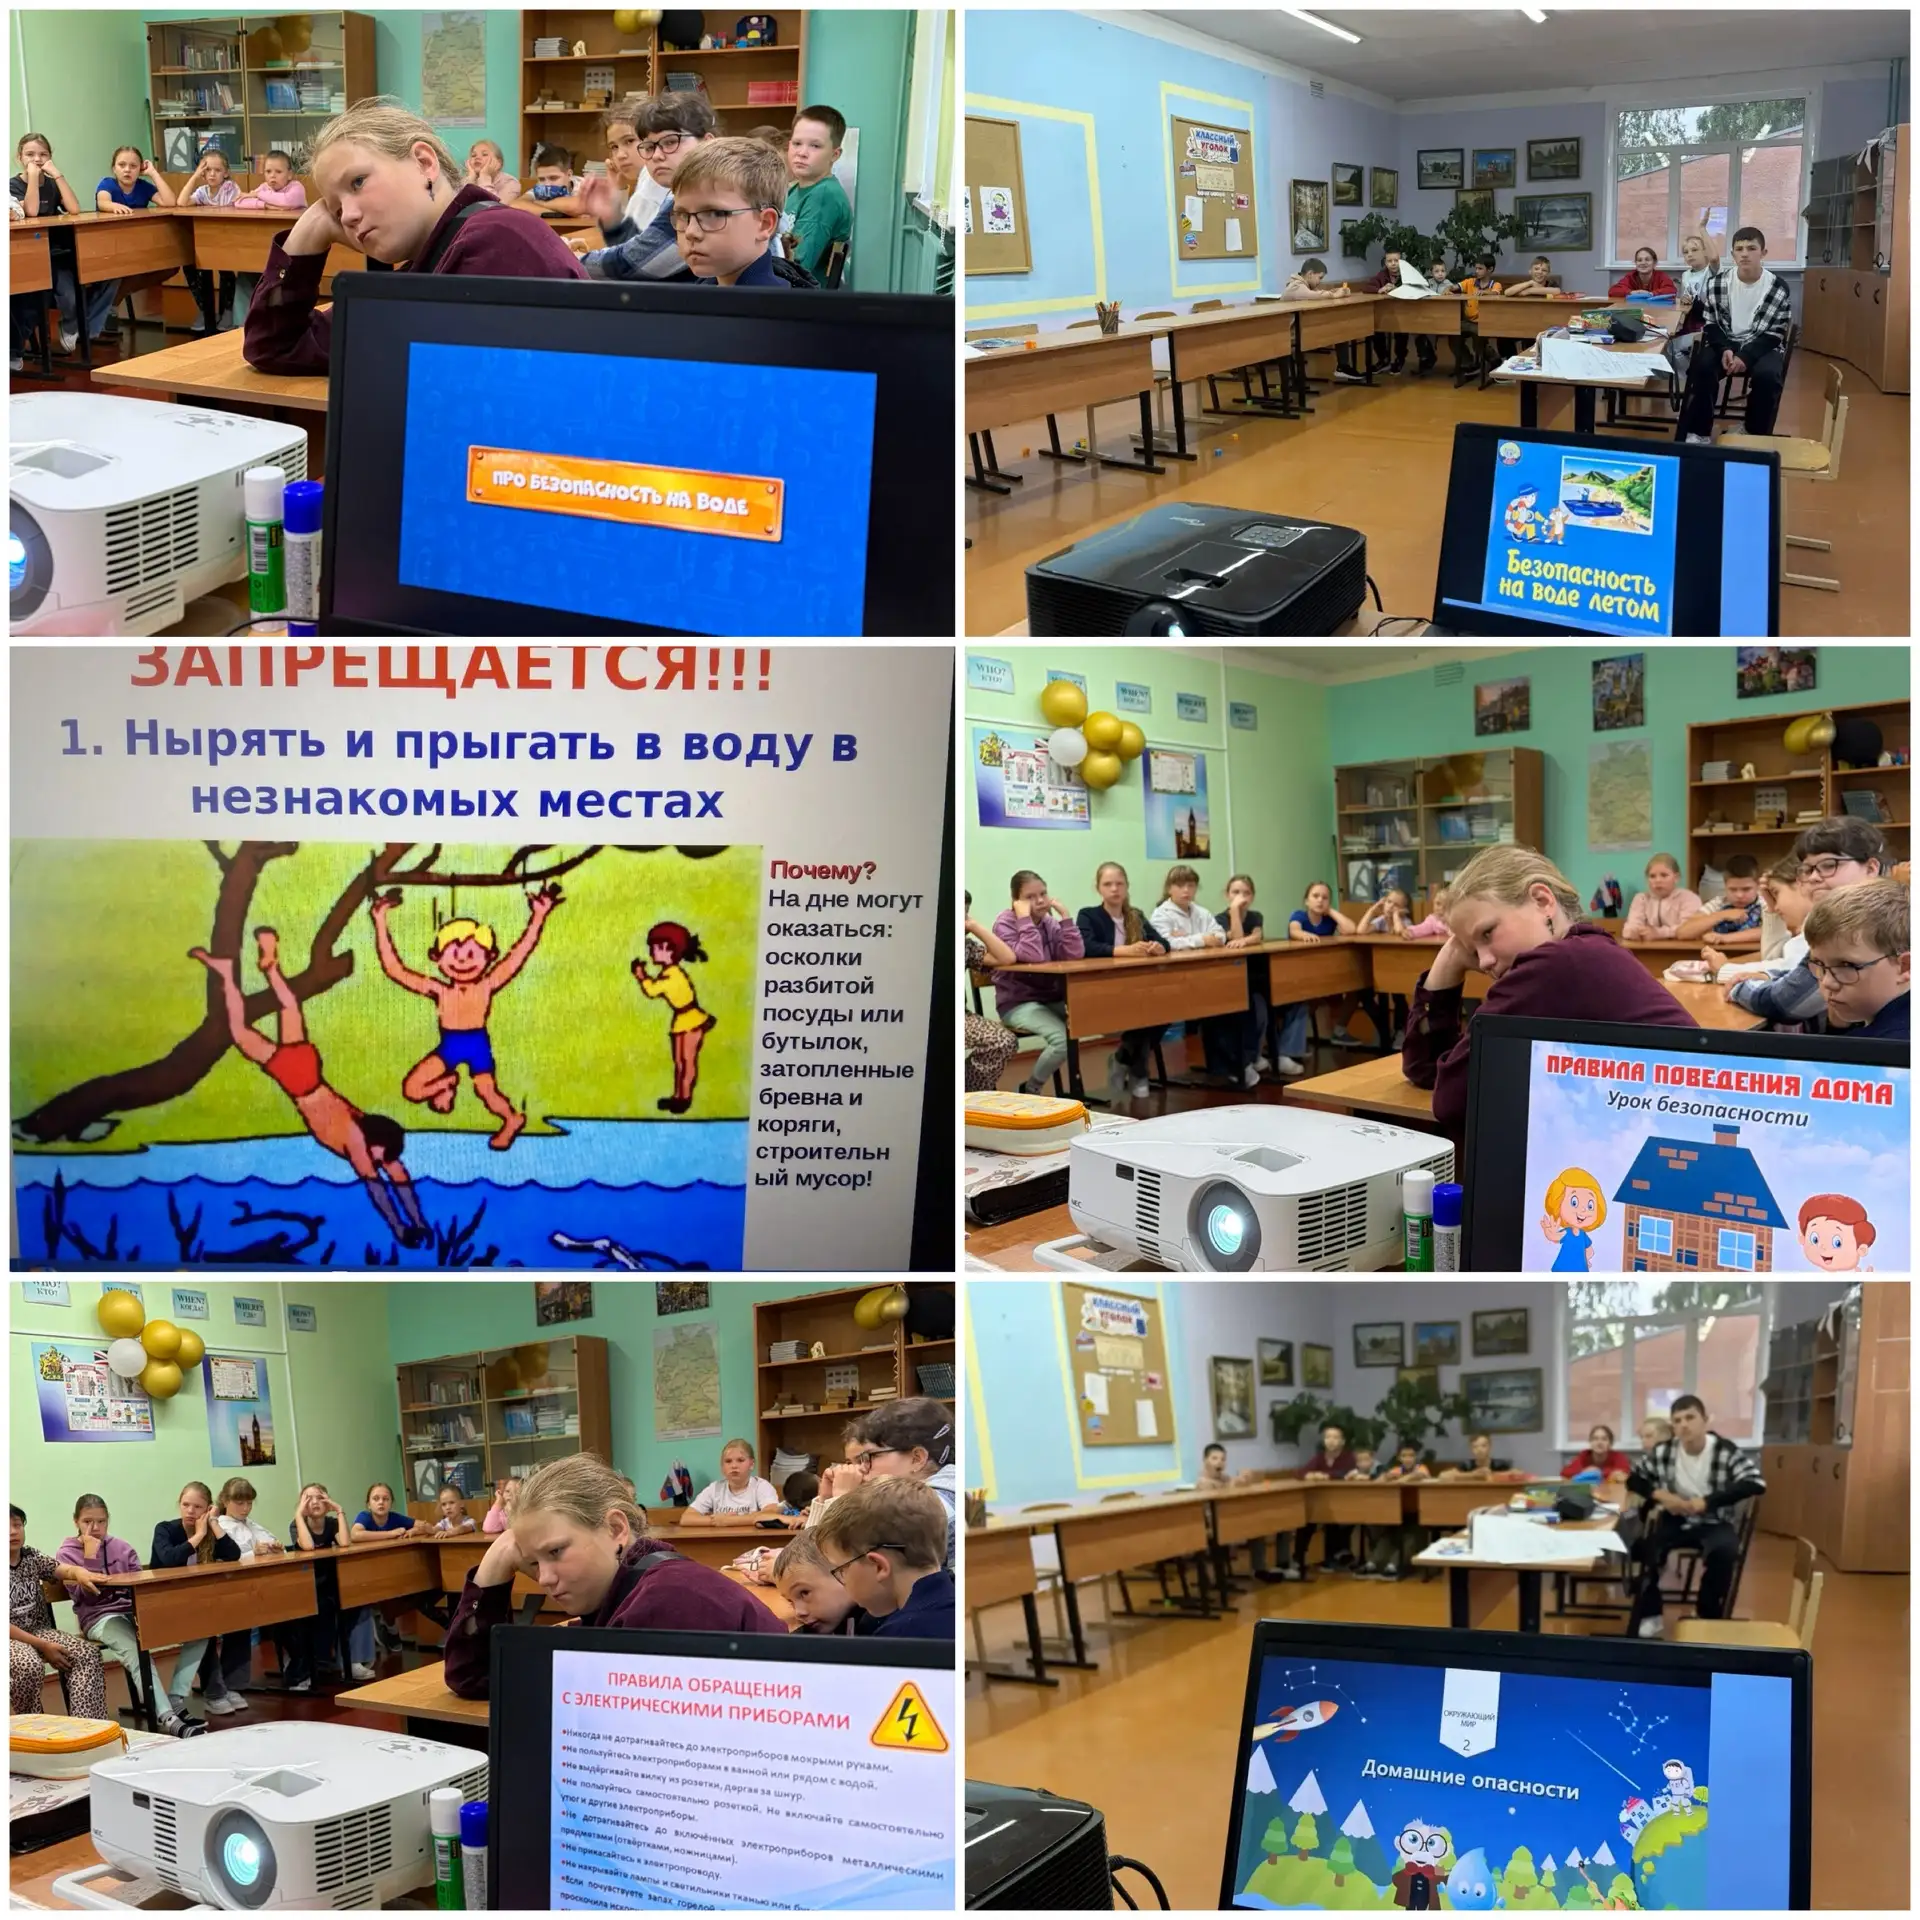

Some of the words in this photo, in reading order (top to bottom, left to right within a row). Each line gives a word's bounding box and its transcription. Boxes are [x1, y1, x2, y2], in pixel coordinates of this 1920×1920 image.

[1195, 131, 1235, 145] КЛАССНЫЙ
[1200, 141, 1229, 152] УГОЛОК
[492, 470, 526, 488] ПРО
[530, 475, 662, 506] БЕЗОПАСНОСТЬ
[666, 490, 692, 509] НА
[696, 492, 750, 516] ВОДЕ
[1506, 548, 1657, 596] Безопасность
[1499, 576, 1525, 599] на
[1531, 581, 1581, 608] воде
[1588, 592, 1660, 623] летом
[129, 646, 772, 700] ЗАПРЕЩАЕТСЯ!!!
[975, 662, 1006, 676] WHO?
[60, 717, 103, 756] 1.
[125, 718, 326, 767] Нырять
[345, 729, 374, 758] и
[396, 729, 616, 769] прыгать
[636, 731, 662, 761] в
[683, 731, 814, 772] воду
[832, 732, 858, 762] в
[191, 783, 519, 818] незнакомых
[538, 787, 725, 819] местах
[770, 860, 877, 884] Почему?
[768, 889, 800, 907] На
[805, 892, 849, 912] дне
[856, 893, 923, 913] могут
[767, 922, 893, 938] оказаться:
[765, 951, 862, 966] осколки
[764, 976, 874, 997] разбитой
[763, 1007, 853, 1026] посуды
[860, 1008, 904, 1023] или
[762, 1031, 868, 1054] бутылок,
[760, 1063, 914, 1078] затопленные
[1547, 1055, 1645, 1082] ПРАВИЛА
[1654, 1064, 1801, 1097] ПОВЕДЕНИЯ
[1811, 1078, 1893, 1105] ДОМА
[759, 1087, 844, 1109] бревна
[849, 1092, 863, 1106] и
[1607, 1090, 1652, 1110] Урок
[1657, 1095, 1809, 1127] безопасности
[757, 1118, 841, 1136] коряги,
[756, 1145, 890, 1163] строительн
[755, 1168, 788, 1186] ый
[796, 1170, 872, 1191] мусор!
[36, 1287, 58, 1297] КТО?
[176, 1294, 206, 1305] WHEN?
[608, 1671, 683, 1691] ПРАВИЛА
[688, 1678, 802, 1700] ОБРАЩЕНИЯ
[562, 1692, 571, 1704] С
[575, 1692, 723, 1719] ЭЛЕКТРИЧЕСКИМИ
[728, 1706, 851, 1730] ПРИБОРАМИ
[1443, 1710, 1496, 1721] ОКРУЖАЮЩИЙ
[1460, 1719, 1476, 1728] МИР
[567, 1728, 600, 1741] Никогда
[614, 1735, 684, 1750] дотрагивайтесь
[686, 1742, 698, 1752] до
[700, 1745, 789, 1762] электроприборов
[791, 1753, 844, 1767] мокрыми
[846, 1760, 894, 1773] руками.
[1463, 1739, 1471, 1751] 2
[579, 1747, 632, 1760] пользуйтесь
[632, 1754, 722, 1772] электроприборами
[731, 1765, 768, 1777] ванной
[770, 1769, 790, 1779] или
[793, 1773, 829, 1785] рядом
[839, 1777, 878, 1791] водой.
[1361, 1758, 1466, 1786] Домашние
[1471, 1775, 1580, 1800] опасности
[640, 1770, 666, 1783] вилку
[682, 1777, 723, 1792] розетки,
[774, 1789, 806, 1802] шнур.
[580, 1780, 632, 1794] пользуйтесь
[636, 1787, 710, 1806] самостоятельно
[714, 1799, 763, 1814] розеткой.
[785, 1810, 843, 1825] включайте
[848, 1818, 945, 1841] самостоятельно
[588, 1798, 618, 1810] другие
[618, 1802, 699, 1823] электроприборы.
[560, 1826, 613, 1843] предметами
[577, 1845, 635, 1863] прикасайтесь
[582, 1812, 650, 1832] дотрагивайтесь
[655, 1826, 668, 1836] до
[674, 1828, 735, 1847] включённых
[741, 1840, 834, 1863] электроприборов
[842, 1856, 945, 1881] металлическими
[565, 1875, 584, 1887] Если
[648, 1893, 673, 1905] запах
[577, 1862, 629, 1879] накрывайте
[630, 1873, 660, 1885] лампы
[670, 1880, 731, 1899] светильники
[732, 1893, 770, 1907] тканью
[560, 1891, 609, 1909] проскочила
